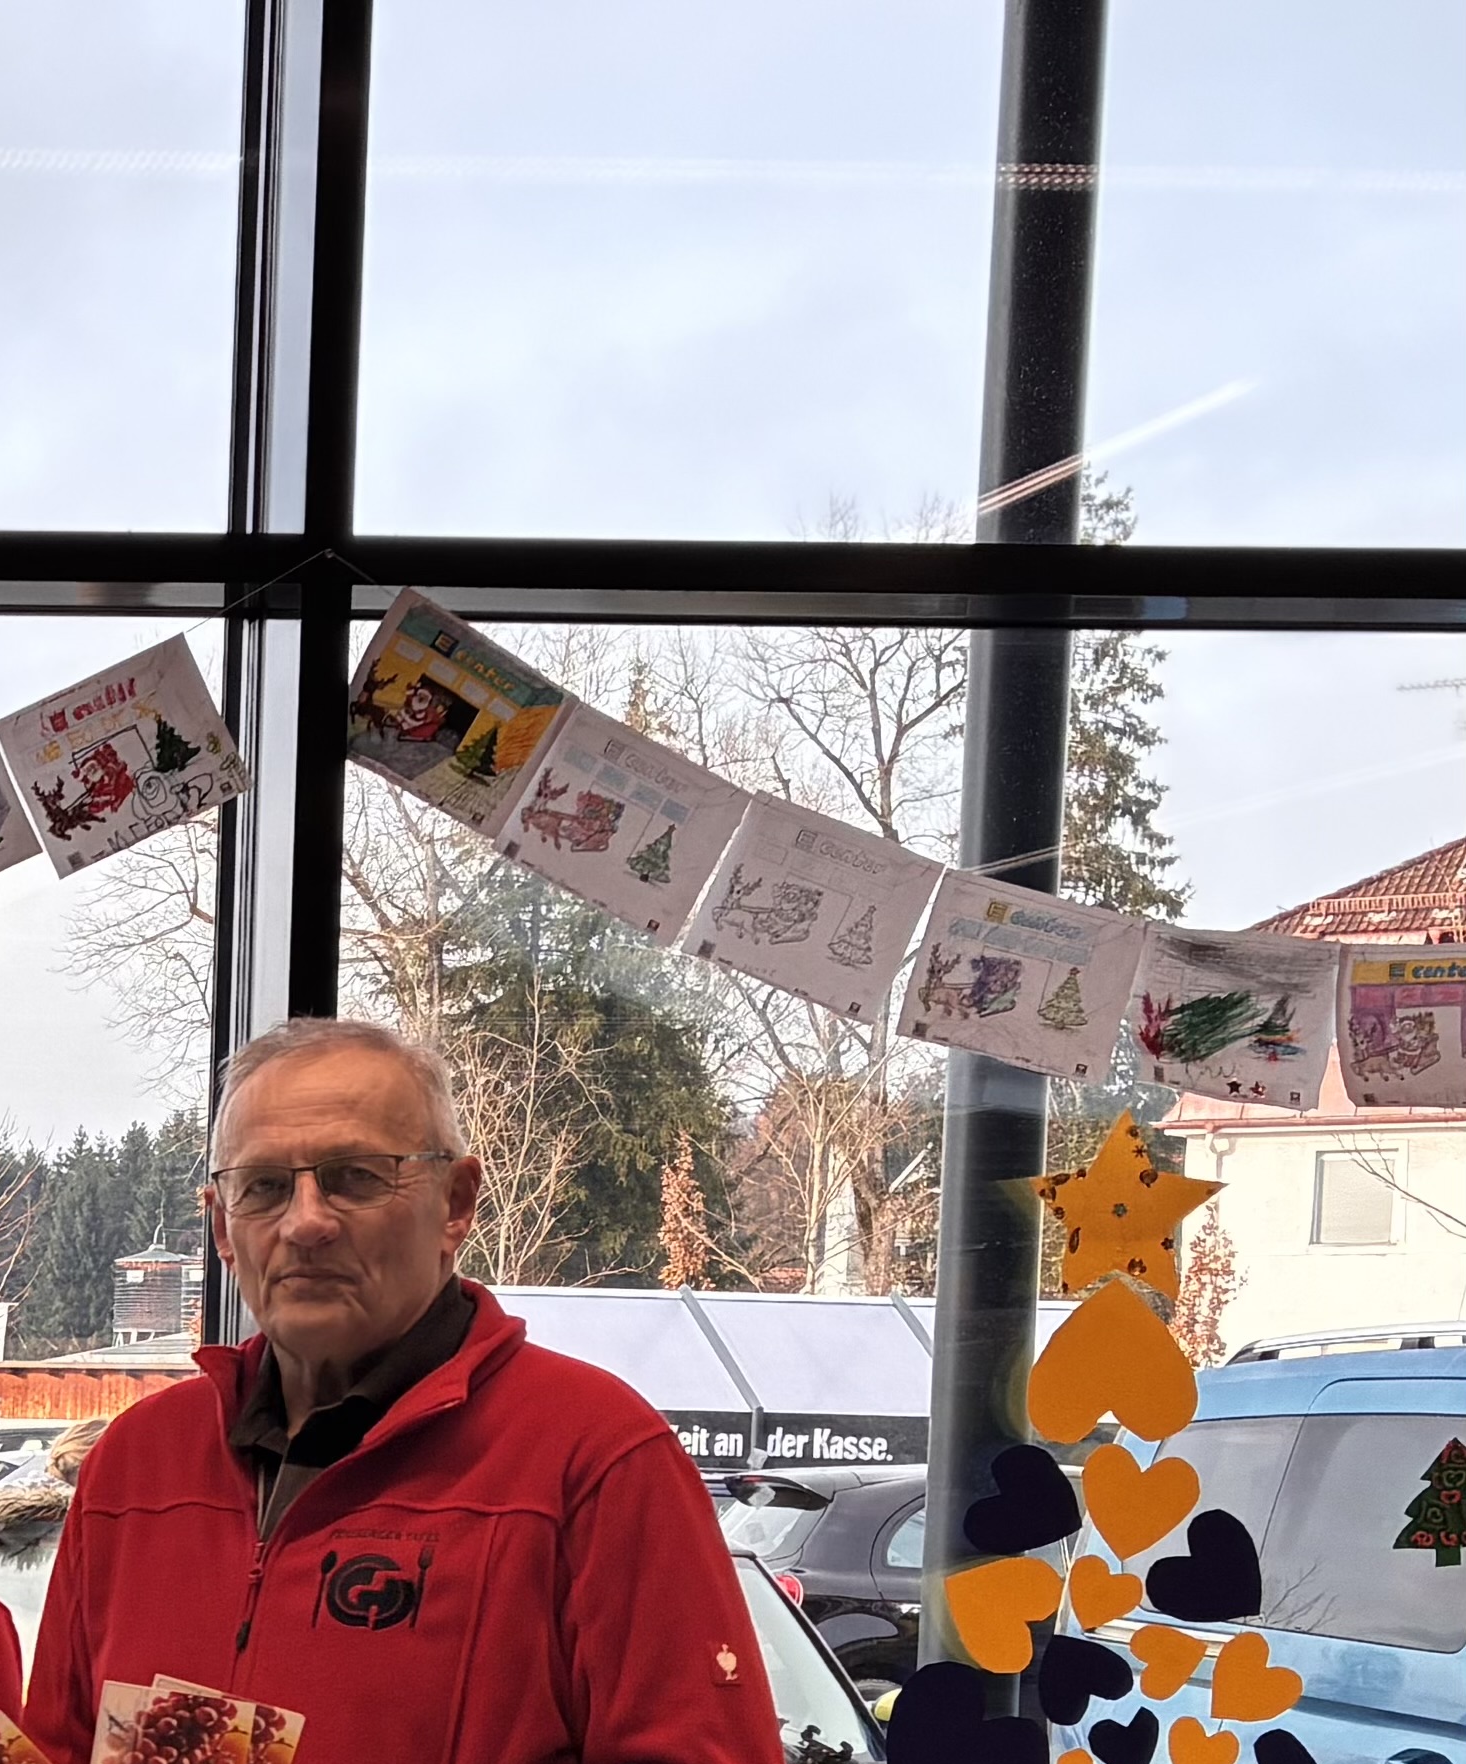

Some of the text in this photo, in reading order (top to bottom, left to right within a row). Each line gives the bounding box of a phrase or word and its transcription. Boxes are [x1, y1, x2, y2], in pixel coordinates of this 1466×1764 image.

[1411, 962, 1466, 979] cente
[714, 1432, 743, 1457] an
[767, 1427, 809, 1458] der
[813, 1428, 894, 1461] Kasse.
